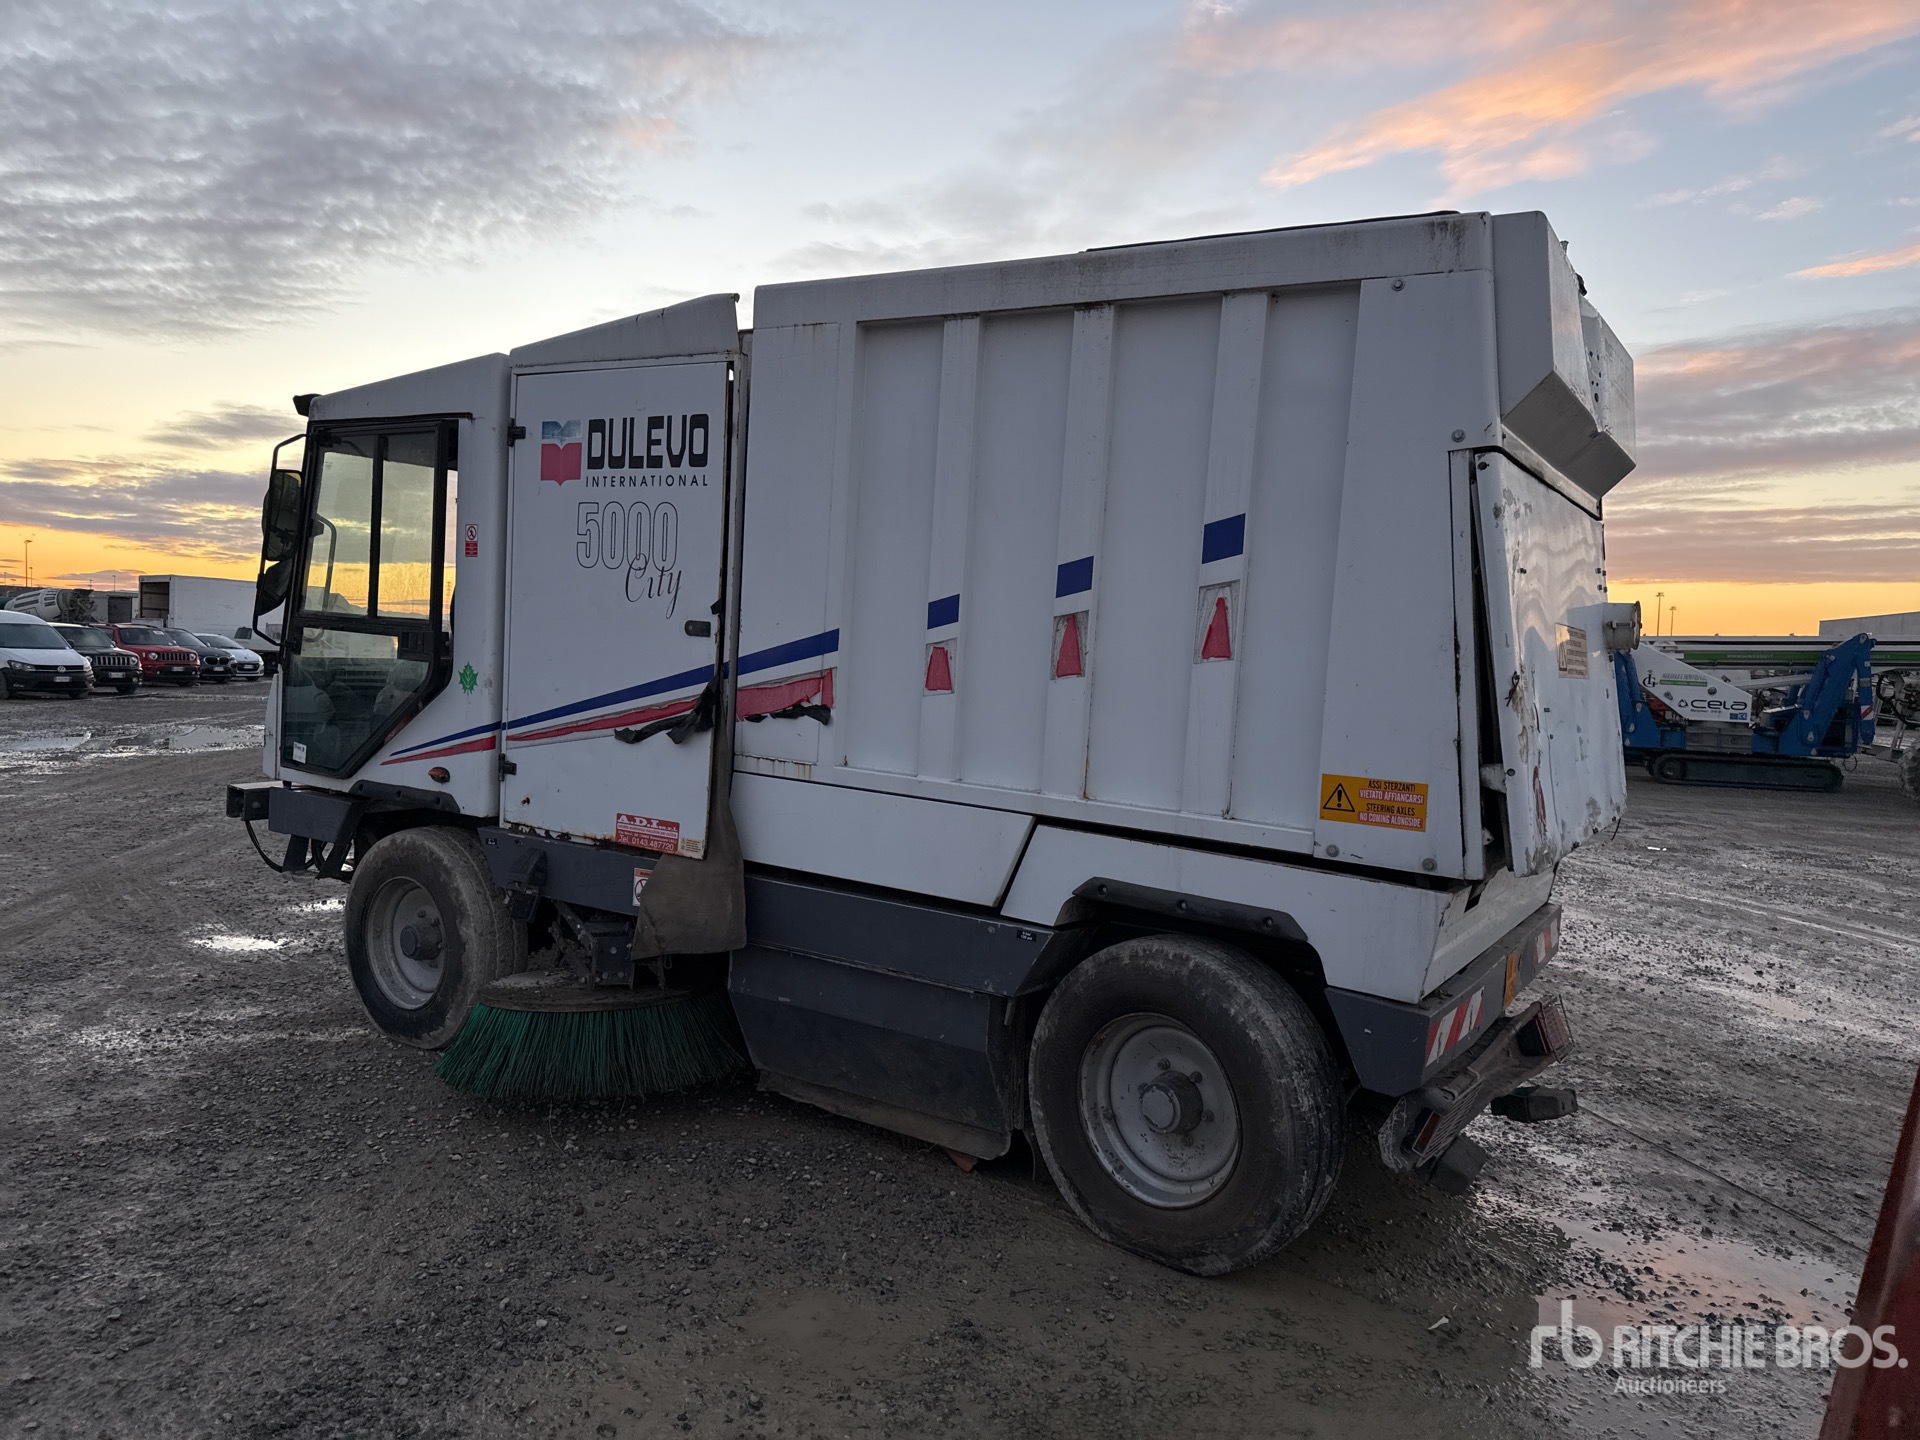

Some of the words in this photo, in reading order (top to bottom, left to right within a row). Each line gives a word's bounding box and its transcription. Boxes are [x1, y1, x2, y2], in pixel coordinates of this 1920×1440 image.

[587, 413, 709, 470] DULEVO
[585, 474, 708, 488] INTERNATIONAL
[577, 501, 678, 572] 5000
[625, 553, 682, 619] City
[1368, 780, 1382, 789] ASSI
[1383, 781, 1416, 792] STERZANTI
[1360, 789, 1383, 800] VIETATO
[1384, 792, 1423, 804] AFFIANCARSI
[1366, 803, 1395, 814] STEERING
[1396, 806, 1416, 816] AXLES
[1359, 812, 1368, 821] NO
[1369, 813, 1389, 824] COMING
[1390, 815, 1421, 827] ALONGSIDE
